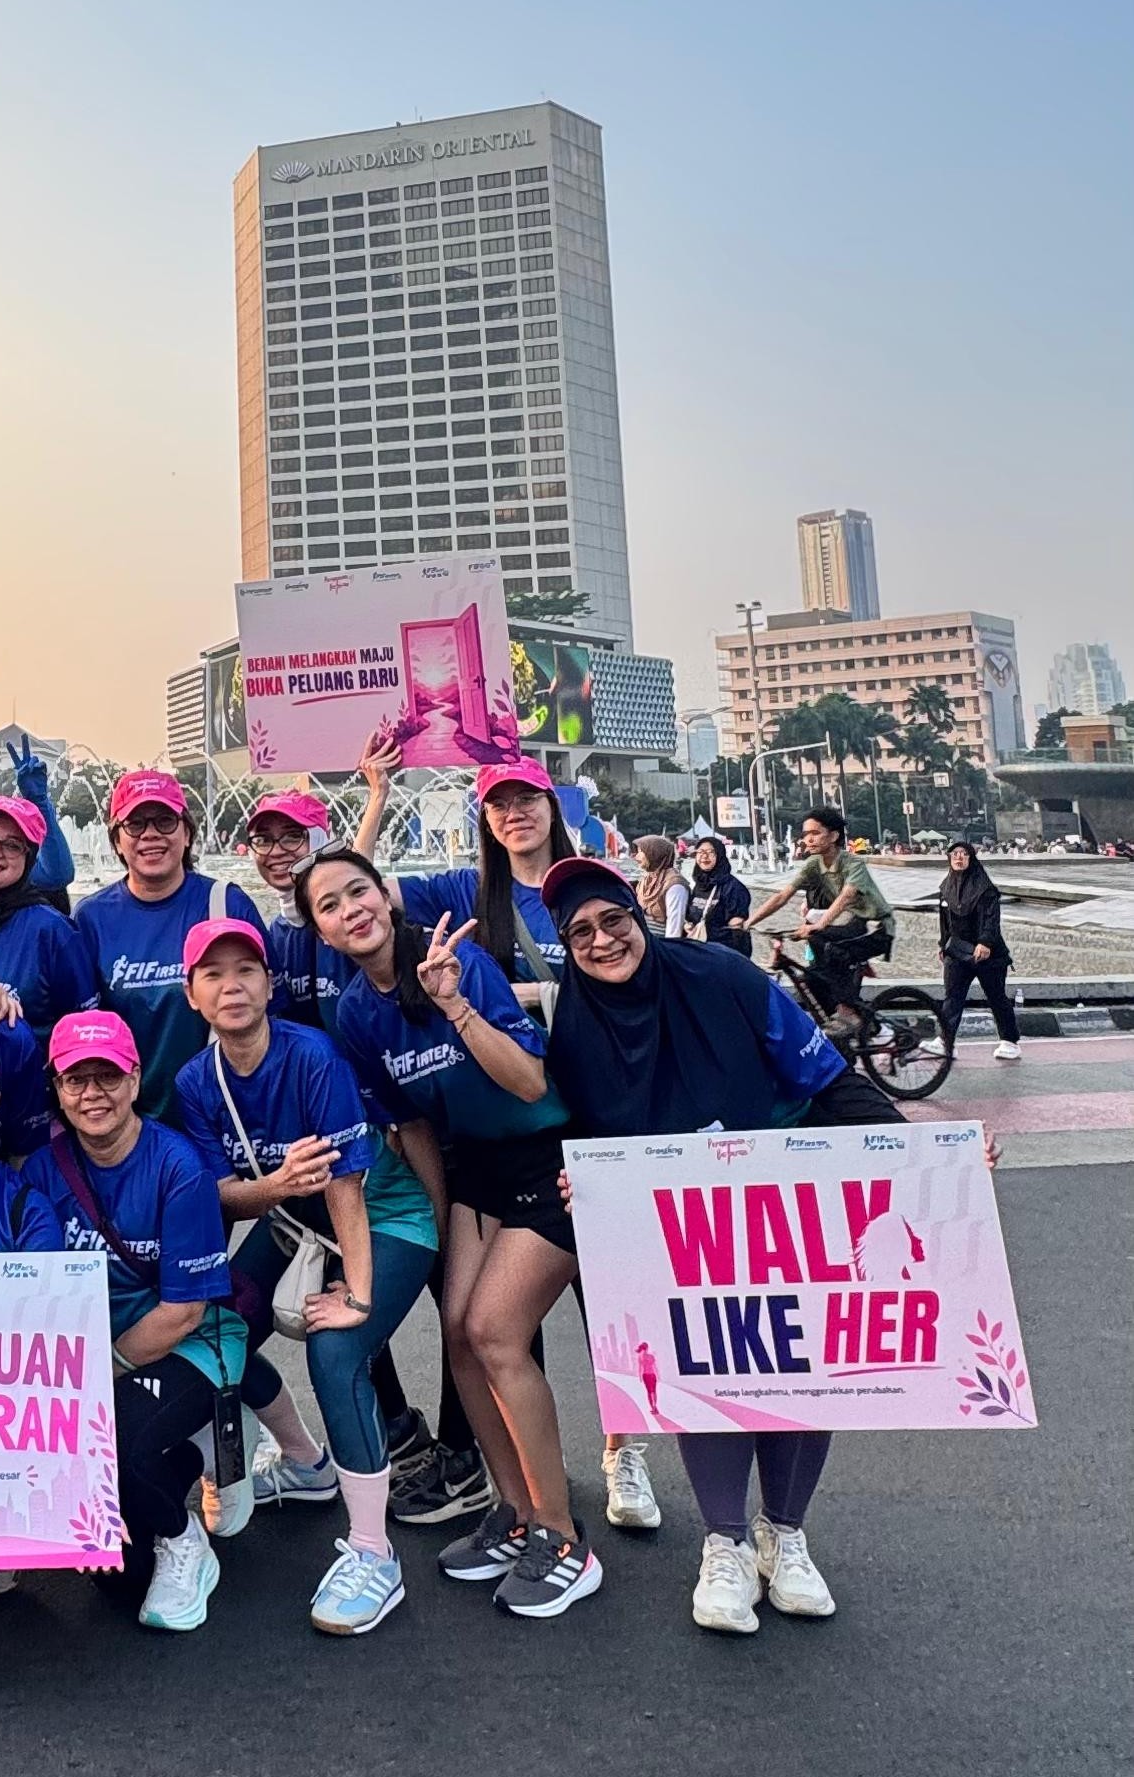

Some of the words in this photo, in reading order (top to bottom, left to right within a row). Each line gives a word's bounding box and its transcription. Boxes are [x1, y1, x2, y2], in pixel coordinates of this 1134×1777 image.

[316, 145, 425, 177] MANDARIN
[432, 128, 536, 160] ORIENTAL
[247, 655, 286, 673] BERANI
[288, 650, 357, 670] MELANGKAH
[360, 646, 394, 664] MAJU
[246, 675, 284, 697] BUKA
[288, 670, 355, 694] PELUANG
[358, 666, 399, 689] BARU
[667, 1294, 811, 1377] LIKE
[823, 1289, 940, 1365] HER
[714, 1388, 740, 1398] Setiap
[741, 1387, 791, 1398] langkahmu,
[792, 1387, 855, 1397] menggerakkan
[857, 1385, 906, 1396] perubahan.
